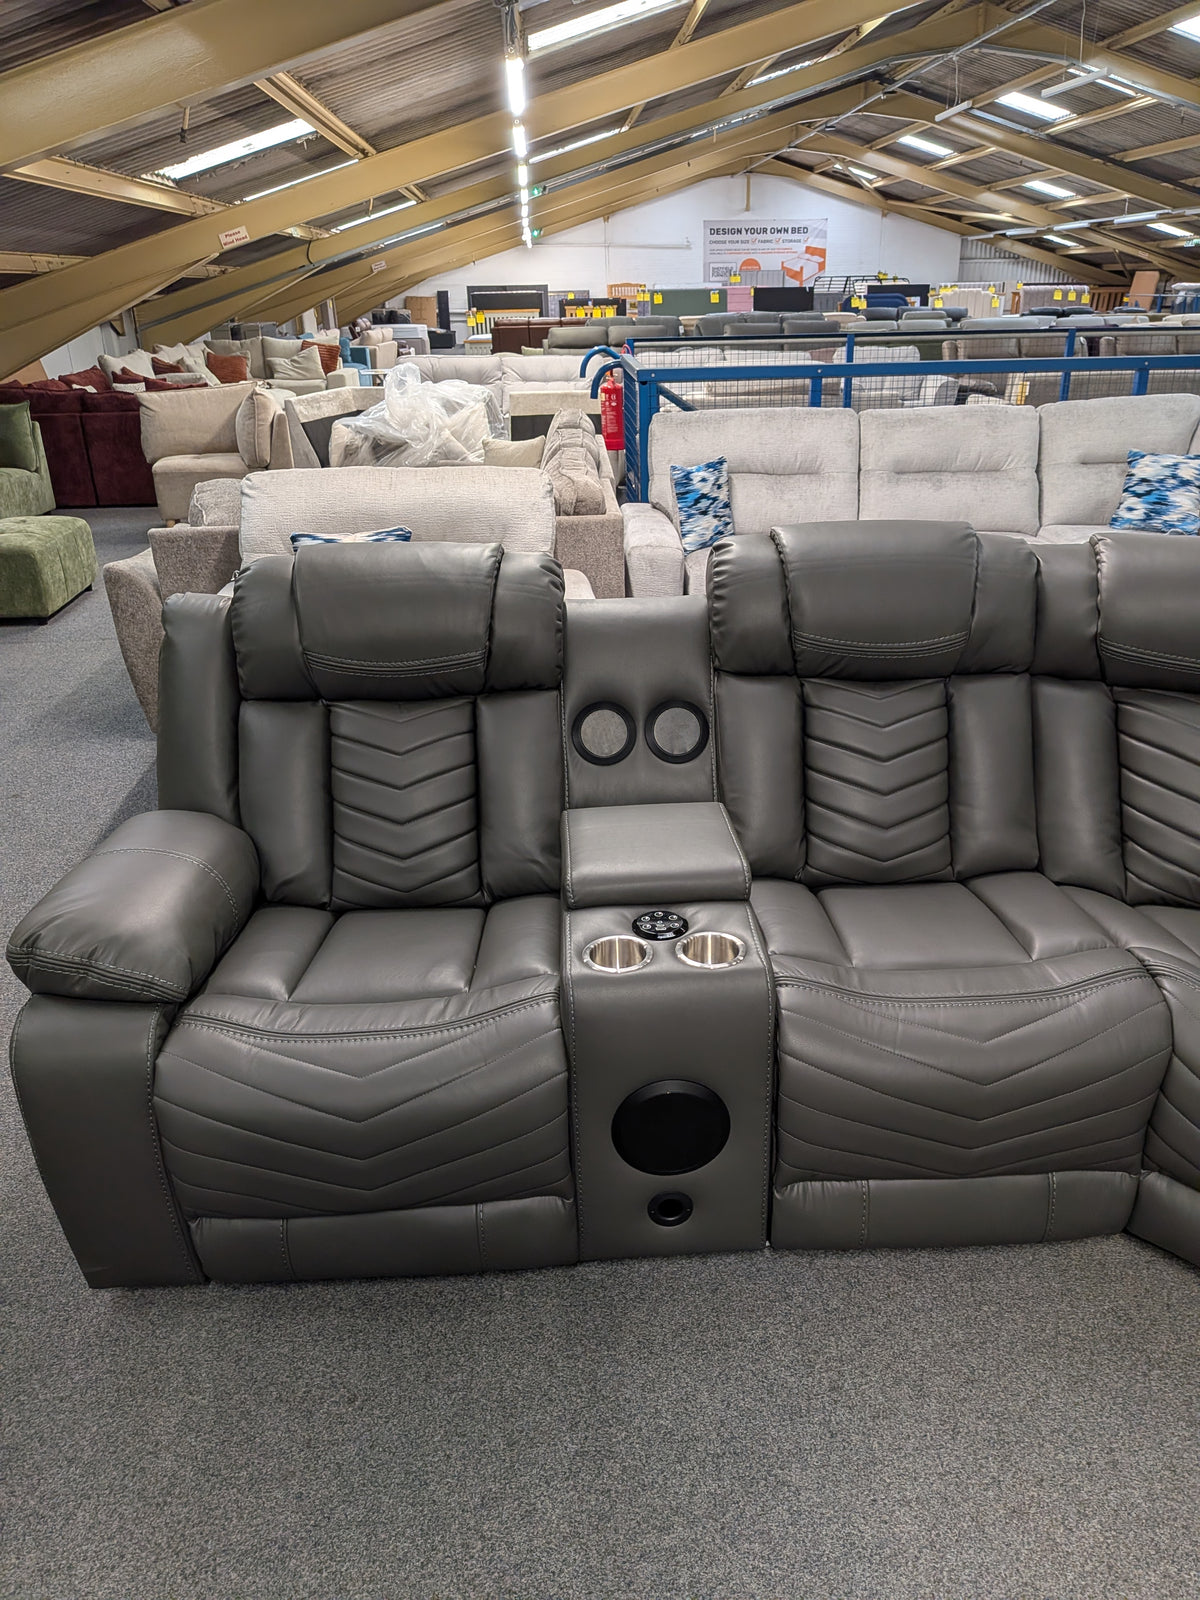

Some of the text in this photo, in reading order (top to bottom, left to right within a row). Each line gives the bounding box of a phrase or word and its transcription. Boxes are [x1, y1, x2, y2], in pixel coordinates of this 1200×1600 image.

[224, 230, 241, 239] Please
[709, 226, 809, 235] DESIGN YOUR OWN BED
[235, 234, 248, 242] Head
